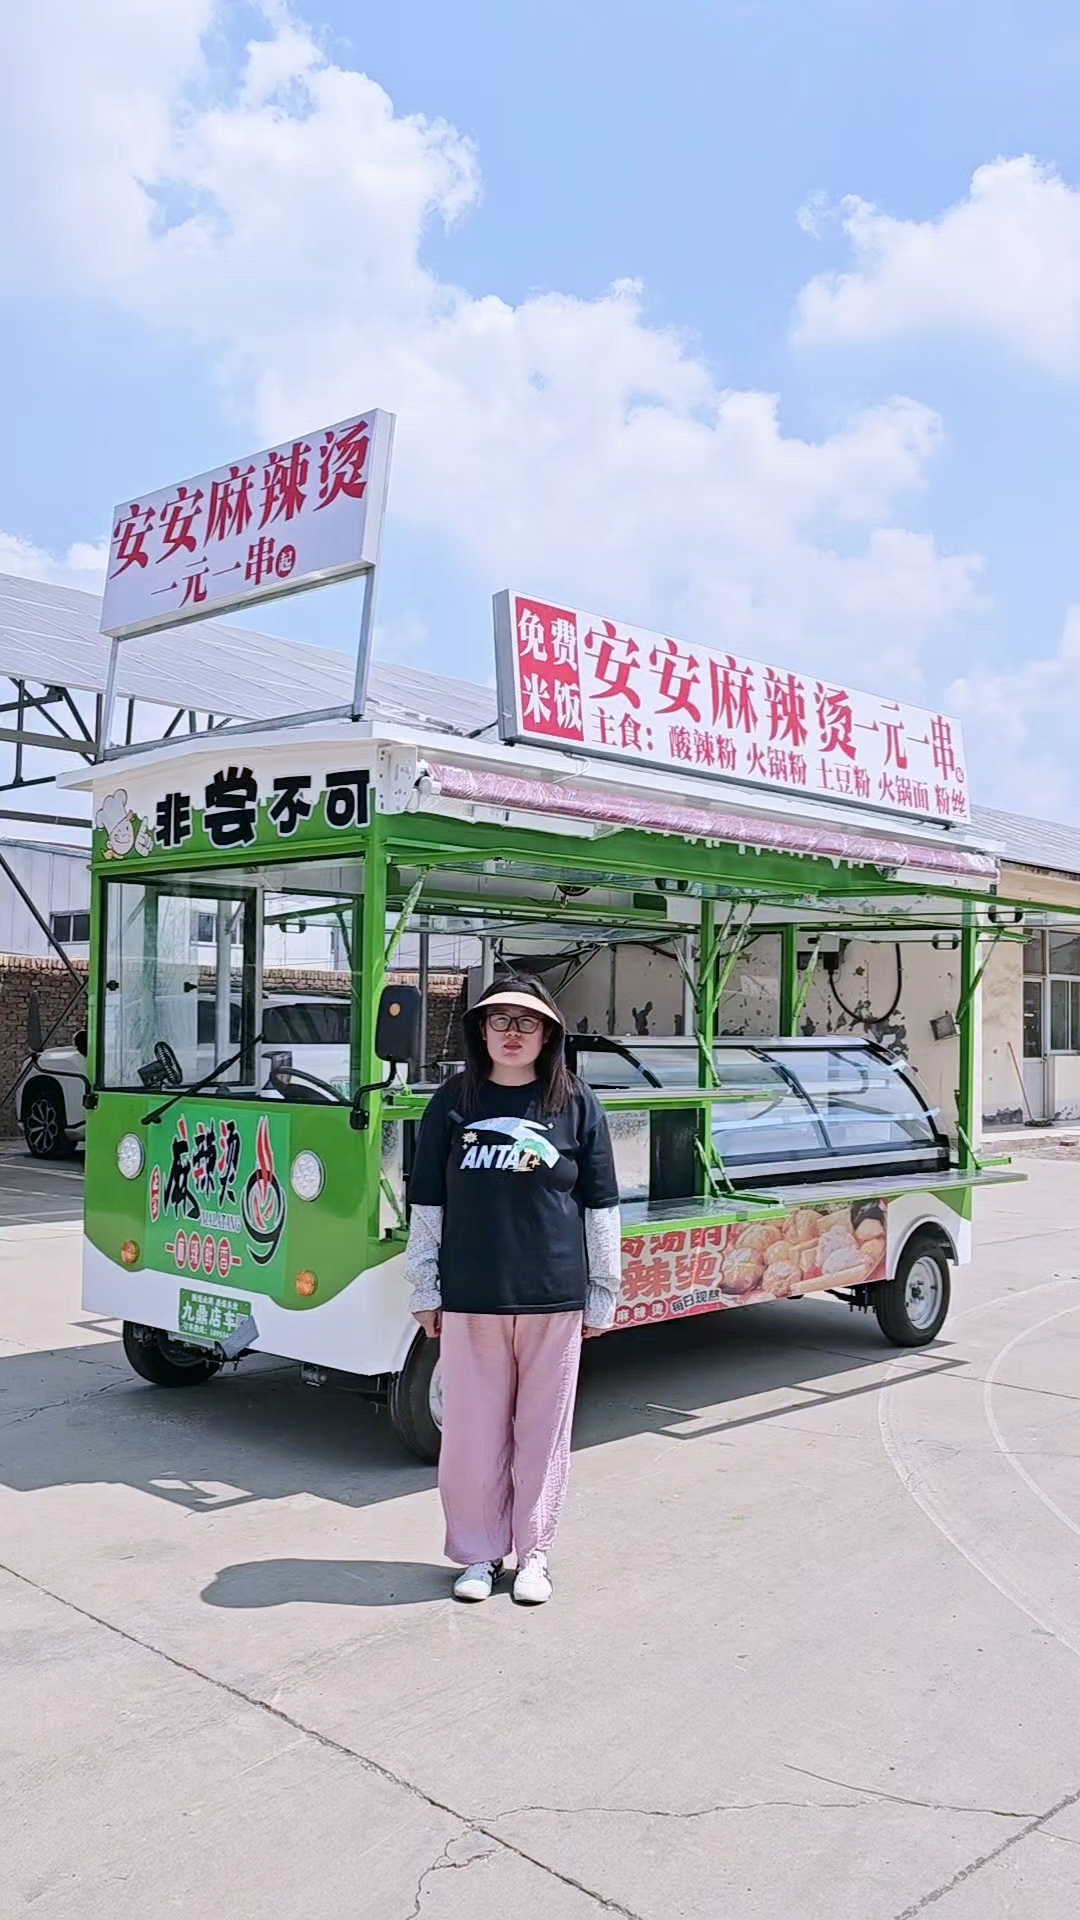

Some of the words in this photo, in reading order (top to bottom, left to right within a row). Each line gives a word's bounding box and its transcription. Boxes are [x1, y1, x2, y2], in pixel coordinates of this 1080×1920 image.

[109, 420, 370, 580] 安安麻辣烫
[516, 608, 578, 671] 免费
[520, 672, 581, 732] 米饭
[155, 766, 370, 847] 非尝不可
[460, 1144, 522, 1170] ANTA
